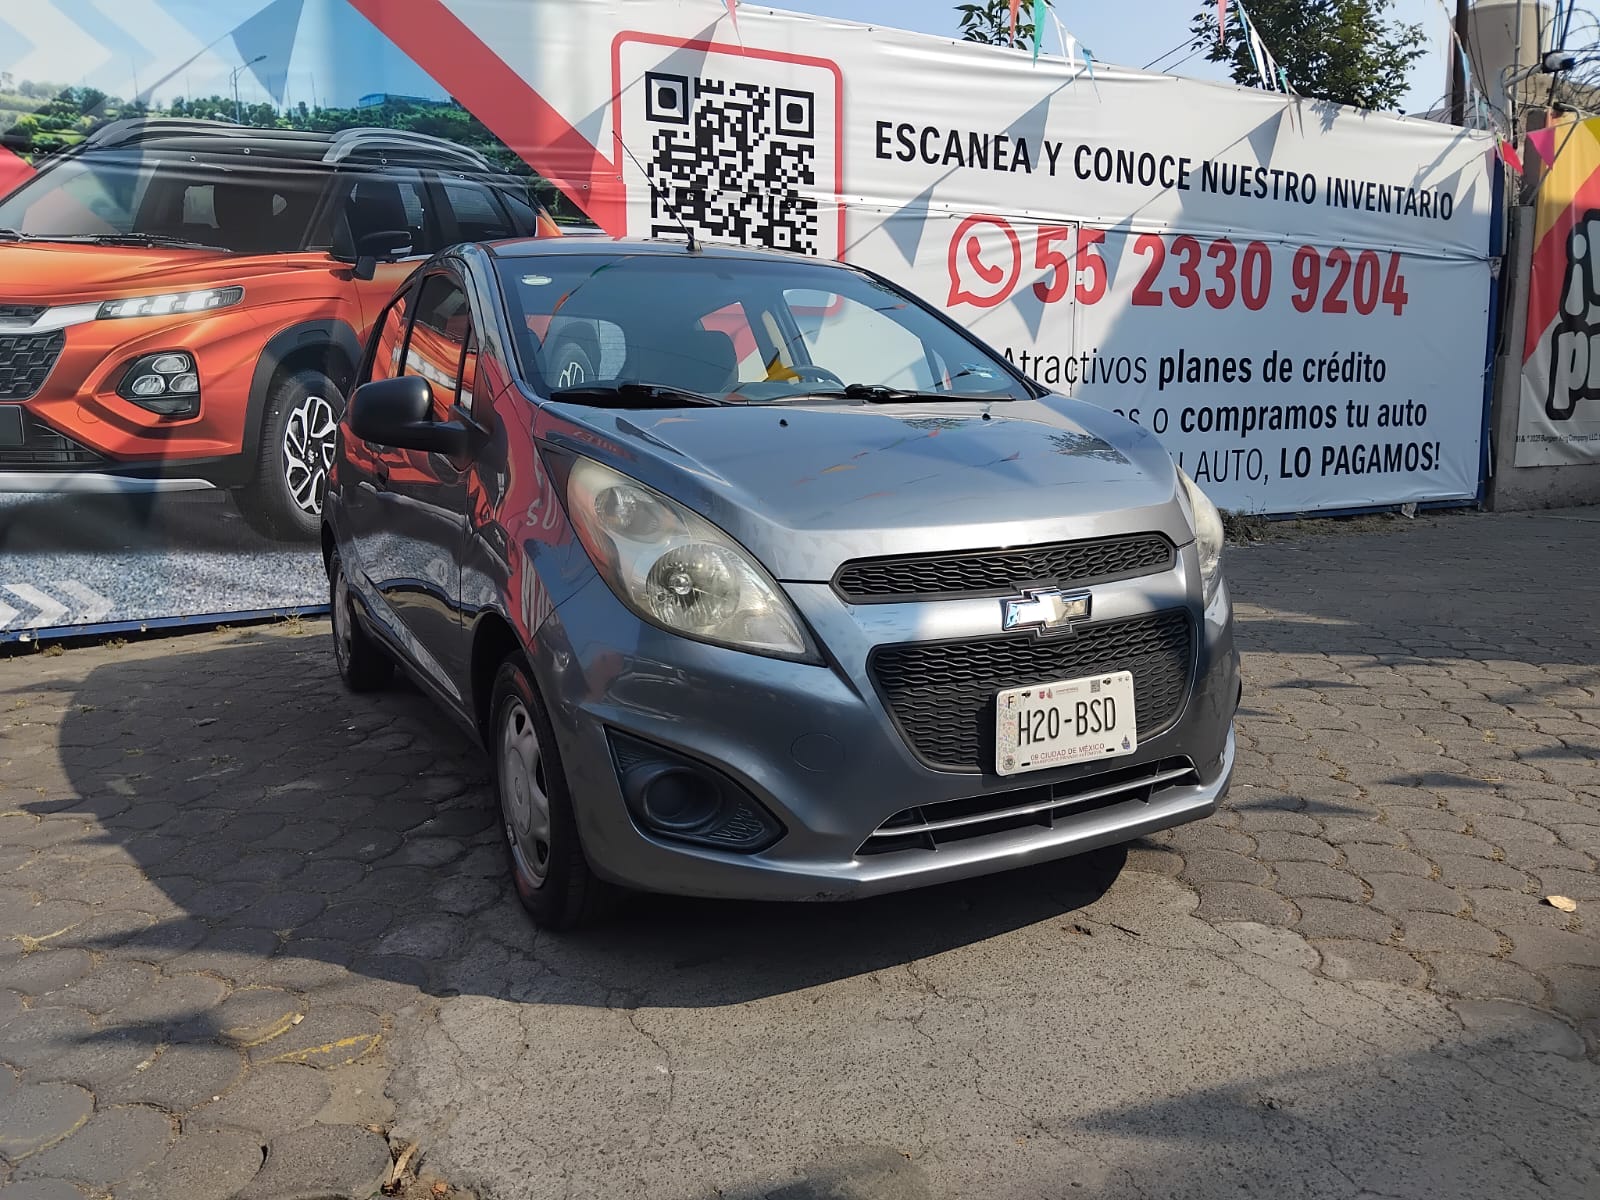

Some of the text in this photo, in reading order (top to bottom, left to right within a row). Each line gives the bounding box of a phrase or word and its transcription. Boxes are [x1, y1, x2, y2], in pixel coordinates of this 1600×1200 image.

[875, 120, 1454, 221] ESCANEA Y CONOCE NUESTRO INVENTARIO
[1034, 225, 1409, 316] 55 2330 9204
[1158, 348, 1252, 391] planes
[1262, 349, 1294, 383] de
[1302, 350, 1387, 383] crédito
[1153, 407, 1169, 434] o
[1180, 404, 1338, 439] compramos
[1345, 399, 1370, 428] tu
[1377, 399, 1428, 428] auto
[1193, 448, 1269, 486] AUTO,
[1279, 446, 1312, 479] LO
[1320, 441, 1441, 477] PAGAMOS!
[1018, 696, 1116, 747] H20-BSD
[1040, 749, 1066, 760] CIUDAD
[1067, 747, 1077, 755] DE
[1078, 742, 1105, 753] MÉXICO
